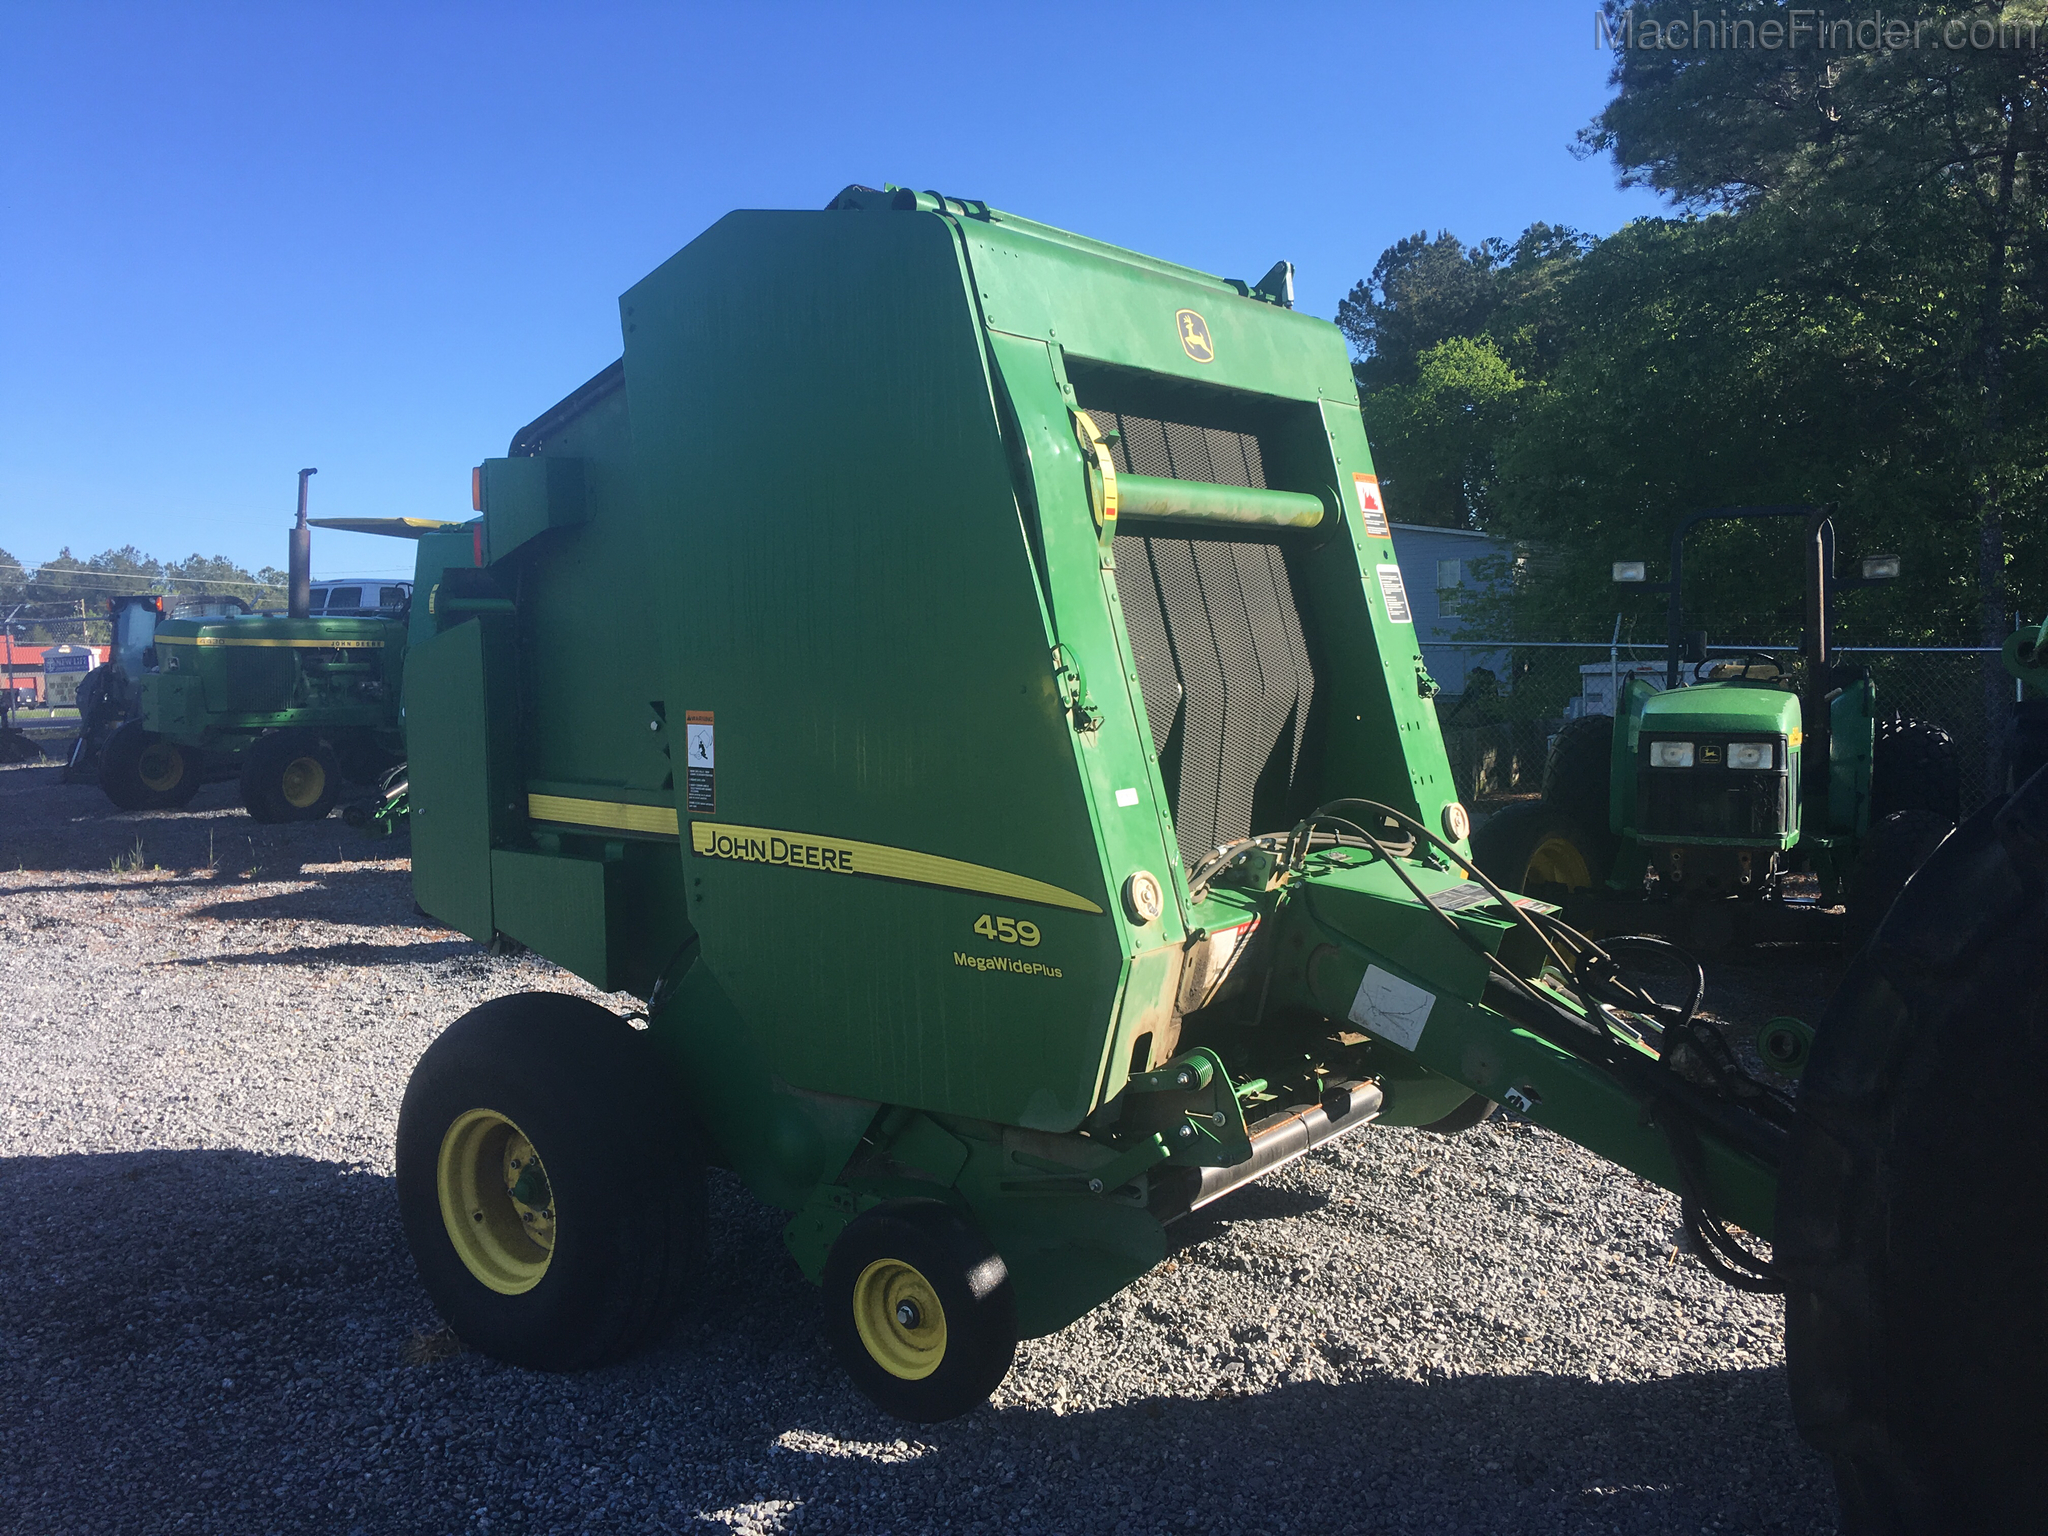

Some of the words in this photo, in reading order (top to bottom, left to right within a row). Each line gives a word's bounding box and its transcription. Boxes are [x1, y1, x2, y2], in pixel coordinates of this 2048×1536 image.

[705, 831, 766, 859] JOHN
[770, 837, 853, 871] DEERE
[973, 914, 1041, 947] 459
[953, 951, 1063, 978] MegaWidePlus
